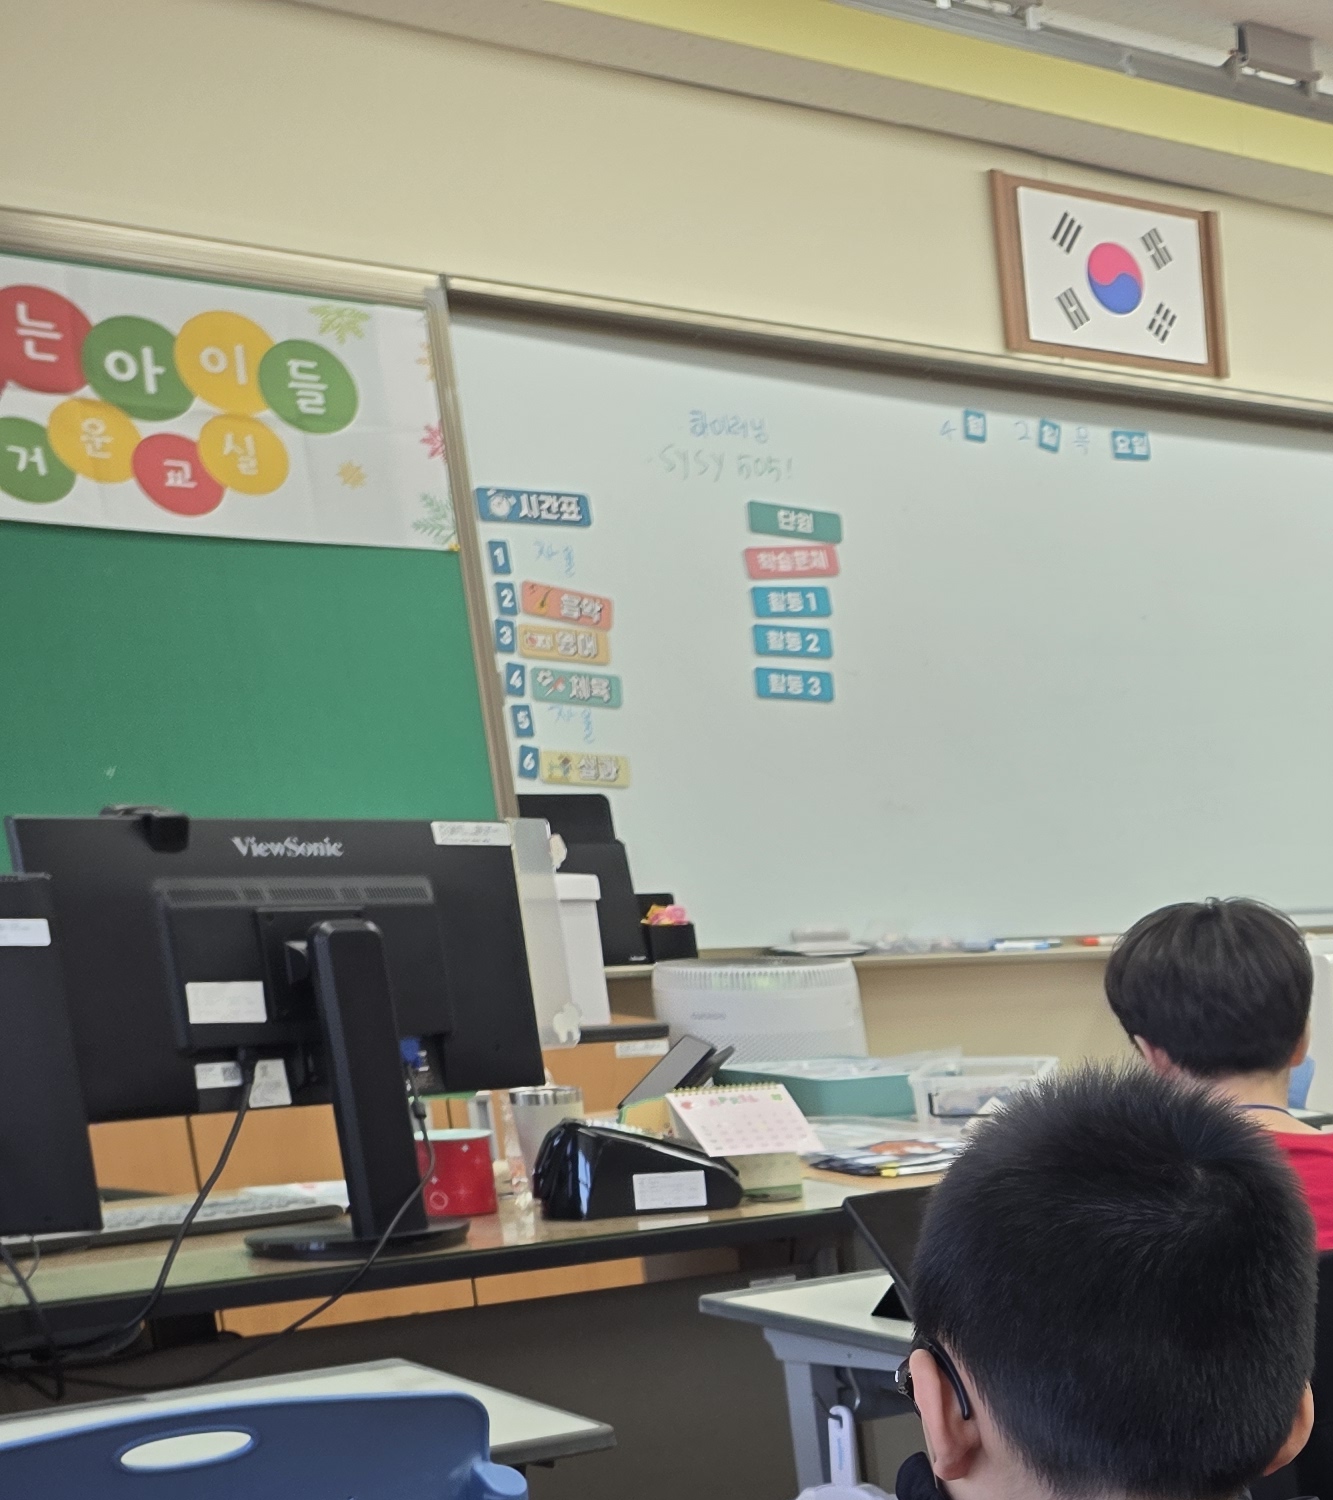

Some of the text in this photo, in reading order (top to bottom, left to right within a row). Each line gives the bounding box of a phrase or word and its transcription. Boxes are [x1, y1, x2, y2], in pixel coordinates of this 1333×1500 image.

[103, 343, 330, 415] 아이들
[1014, 420, 1032, 441] 2
[1115, 434, 1149, 456] 요일
[164, 434, 258, 489] 교실
[519, 493, 582, 521] 시간표
[493, 547, 505, 567] 1
[499, 588, 515, 609] 2
[559, 592, 604, 624] 음악
[499, 625, 513, 647] 3
[556, 631, 598, 659] 영어
[804, 633, 821, 653] 2
[509, 670, 524, 691] 4
[807, 675, 823, 697] 3
[516, 709, 531, 731] 5
[522, 752, 536, 771] 6
[230, 835, 345, 858] ViewSonic
